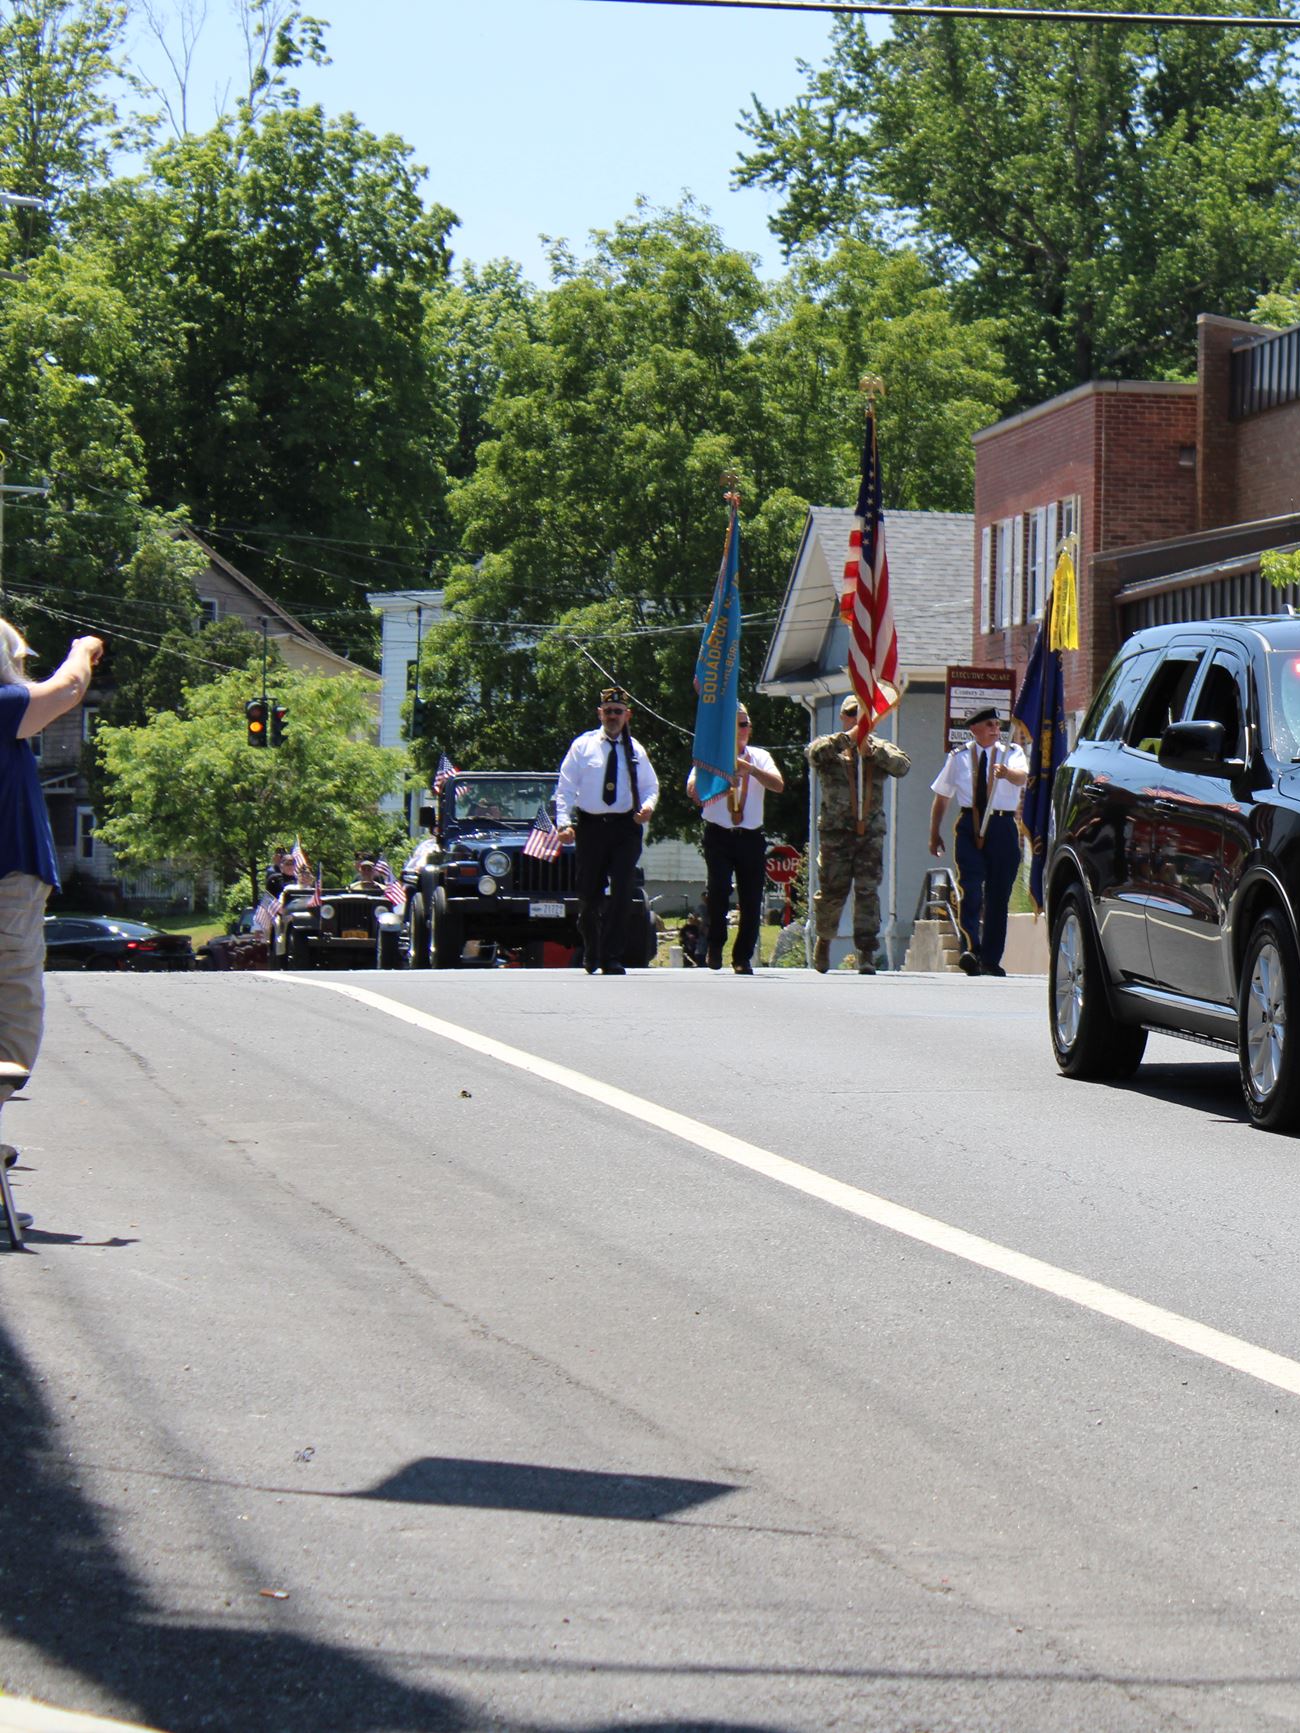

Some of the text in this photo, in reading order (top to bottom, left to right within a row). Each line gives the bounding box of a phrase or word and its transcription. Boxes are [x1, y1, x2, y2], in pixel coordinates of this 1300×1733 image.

[702, 616, 729, 704] SQUADRON
[951, 671, 1011, 681] EXECUTIVE SQUARE
[950, 730, 974, 741] BUILDIN
[766, 857, 800, 872] STOP
